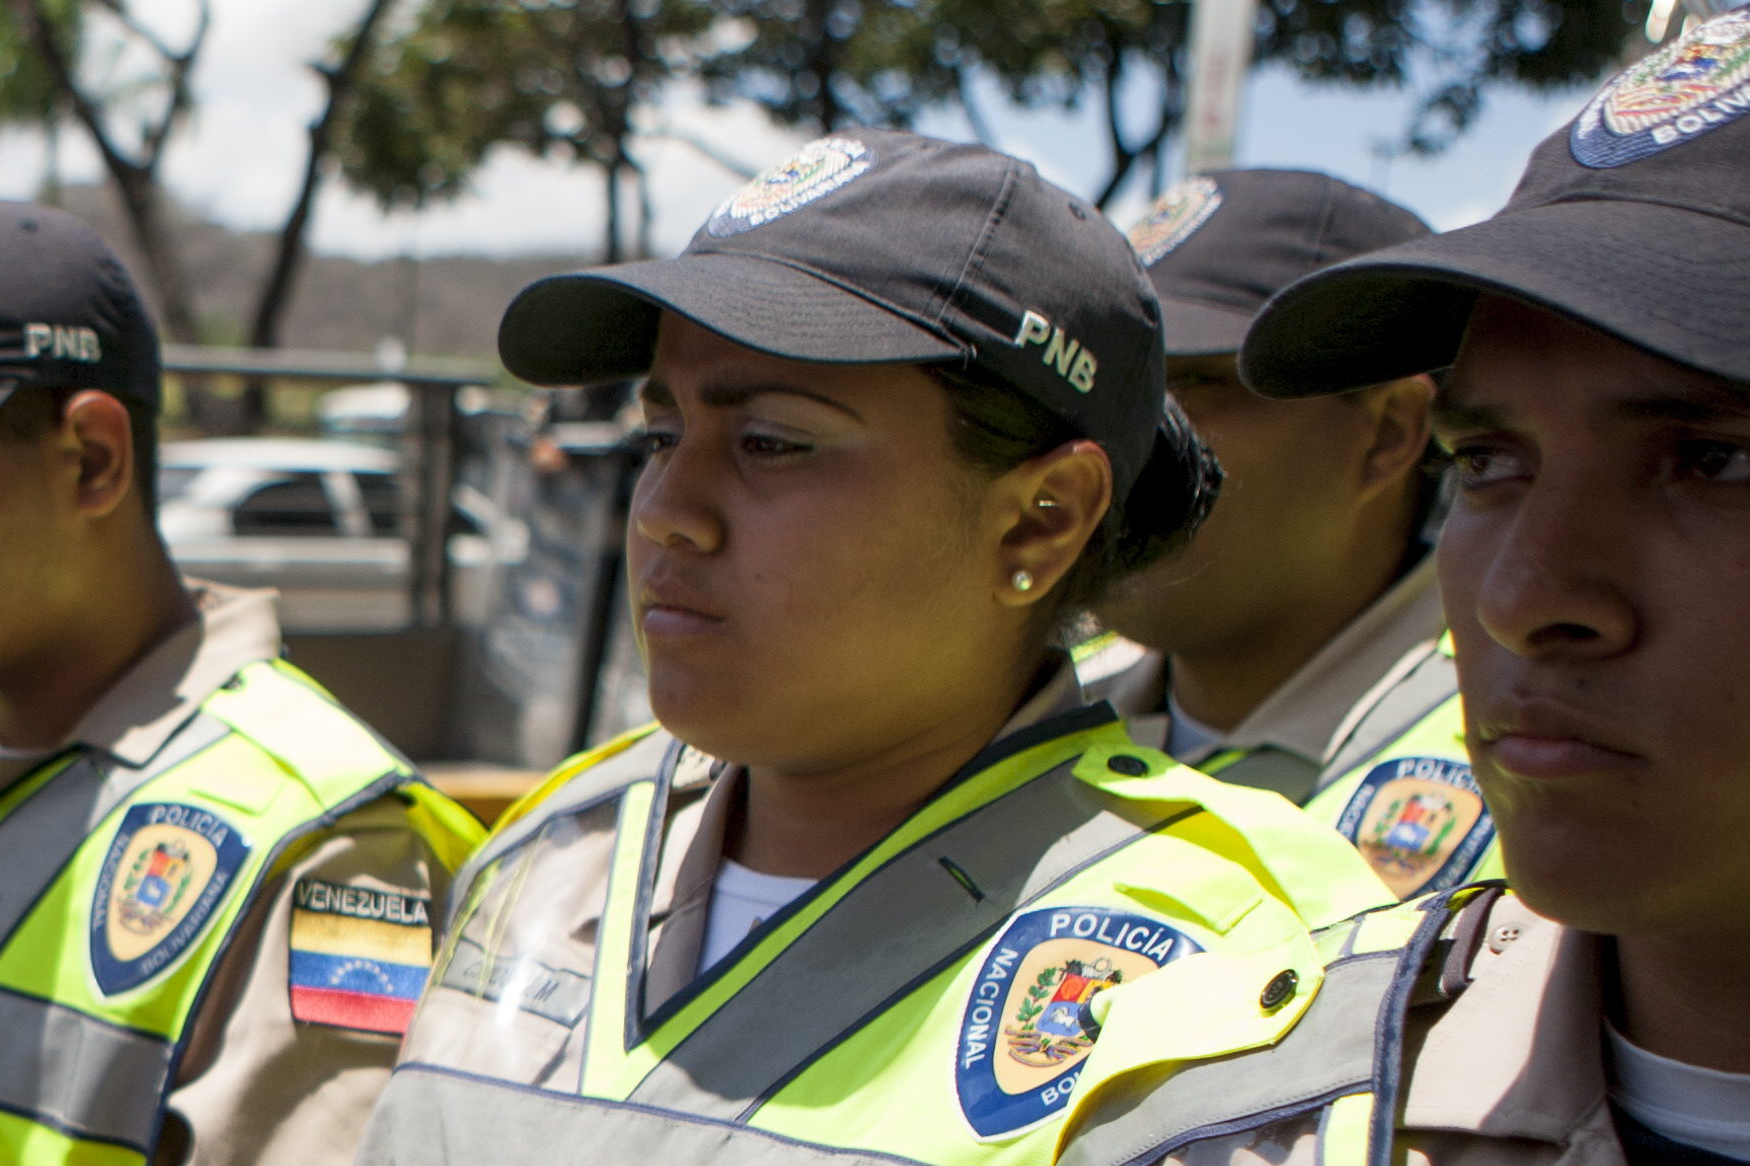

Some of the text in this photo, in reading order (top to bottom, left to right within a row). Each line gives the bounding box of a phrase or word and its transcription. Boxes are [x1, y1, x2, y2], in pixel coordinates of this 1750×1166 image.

[25, 322, 102, 362] PNB
[1015, 309, 1098, 394] PNB
[1396, 759, 1476, 793] POLIC
[298, 881, 429, 924] VENEZUELA
[965, 947, 1018, 1070] NACIONAL
[1040, 1071, 1081, 1106] BO
